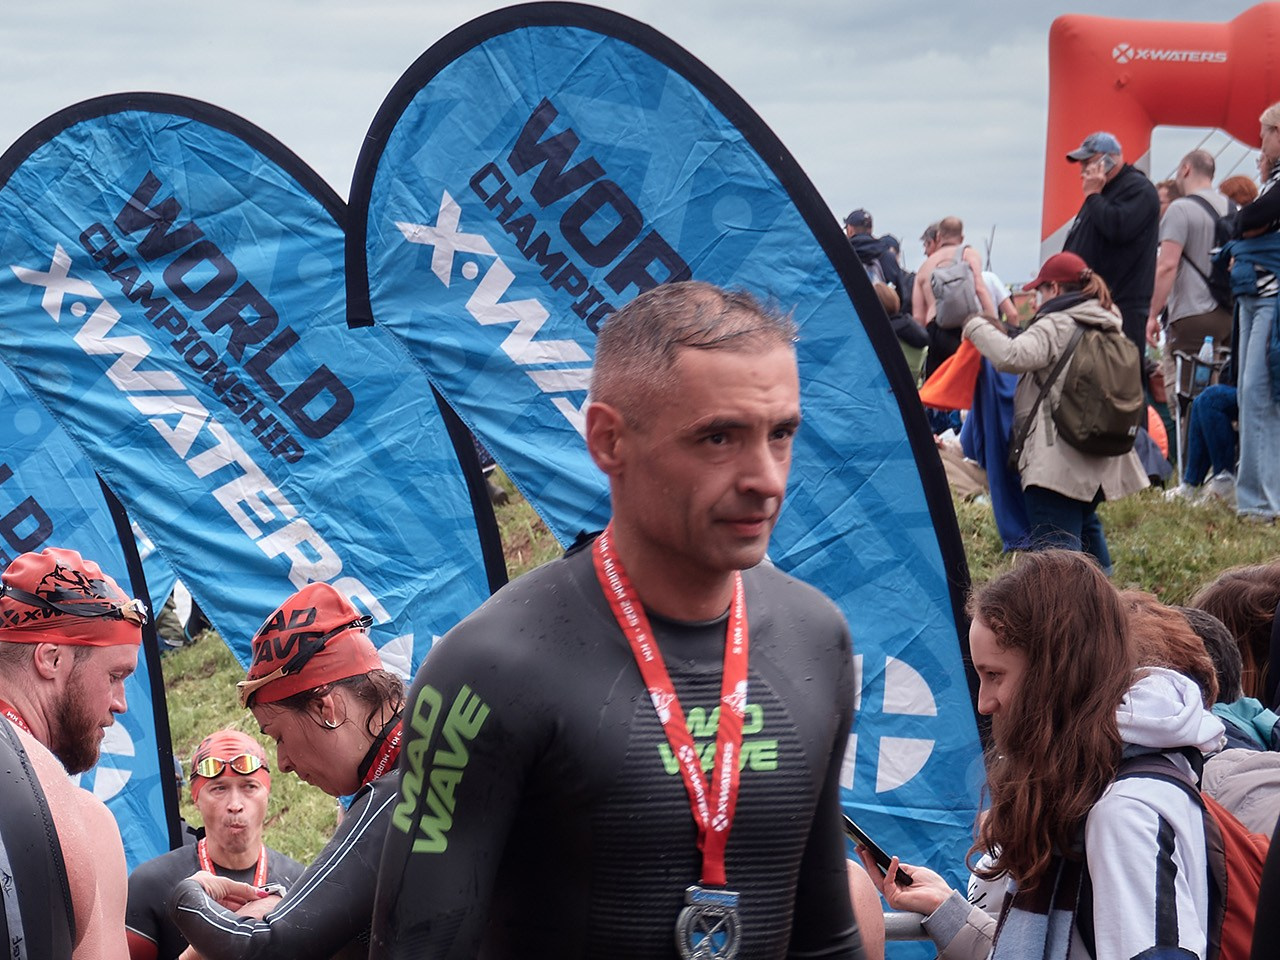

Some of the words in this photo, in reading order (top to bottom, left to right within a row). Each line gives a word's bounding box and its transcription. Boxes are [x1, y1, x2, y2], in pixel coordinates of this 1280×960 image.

[470, 162, 618, 336] CHAMPIO
[507, 96, 692, 295] WOR
[79, 222, 305, 465] CHAMPIONSHIP
[114, 170, 355, 438] WORLD
[259, 606, 317, 637] AD
[603, 558, 627, 600] MUROM
[392, 683, 443, 834] MAD
[412, 684, 491, 854] WAVE
